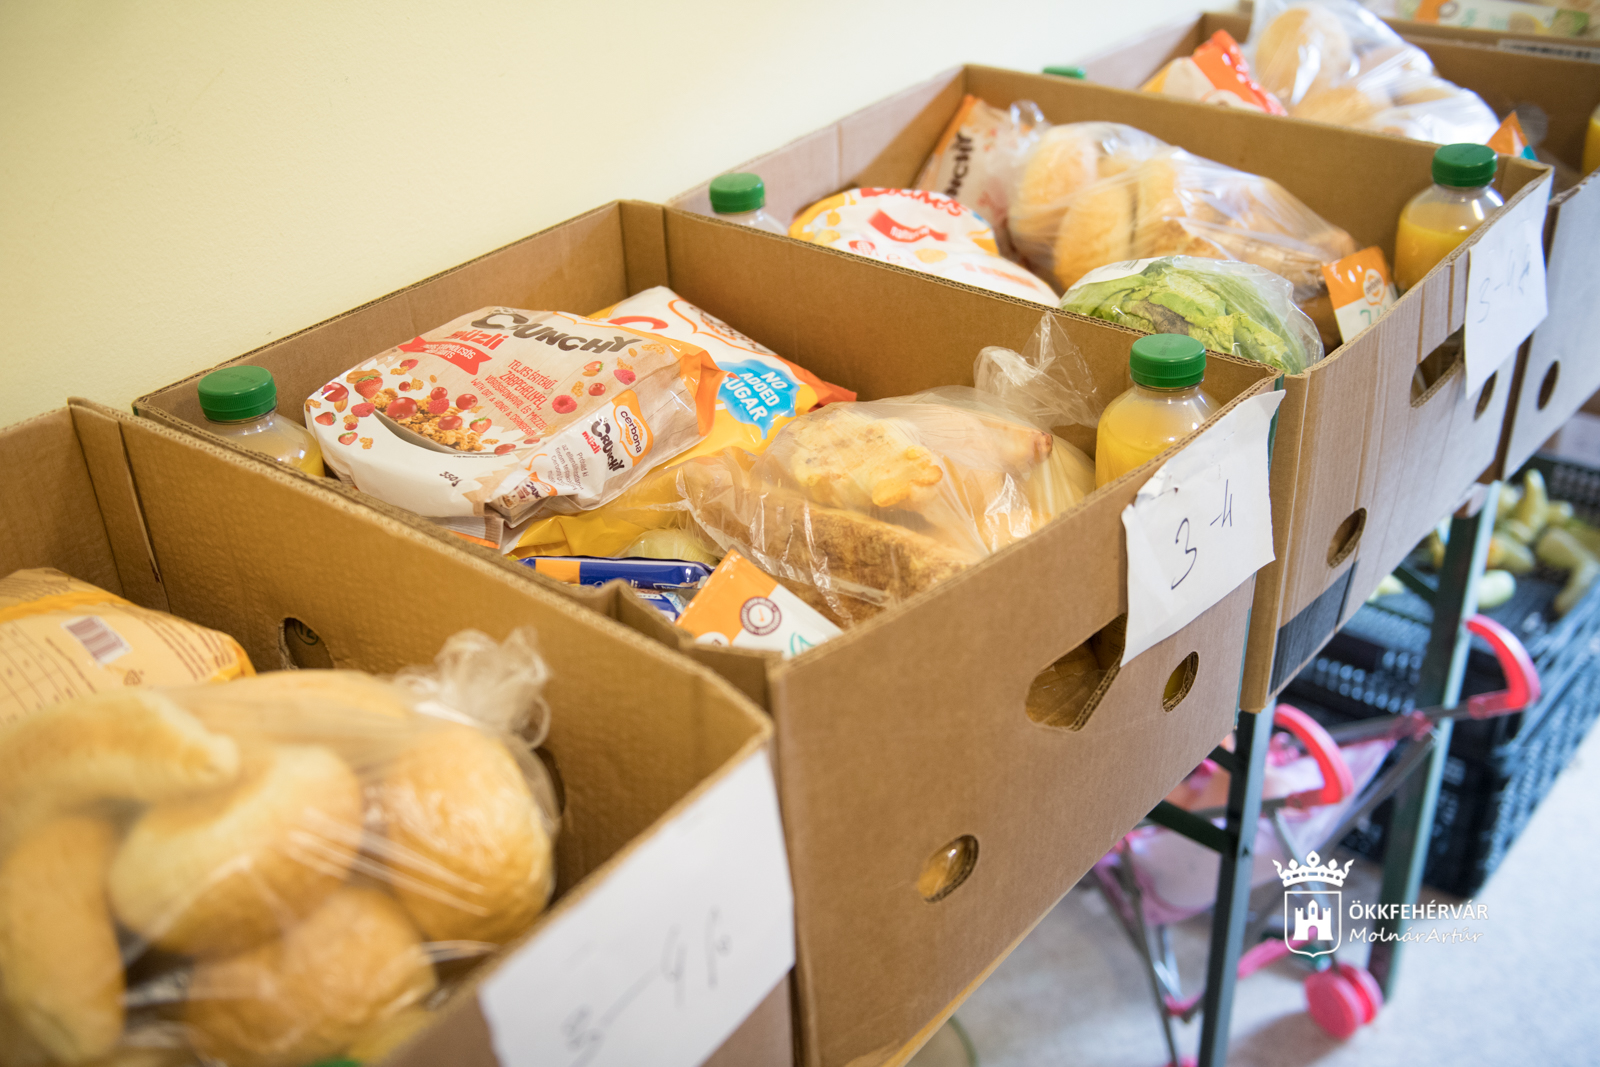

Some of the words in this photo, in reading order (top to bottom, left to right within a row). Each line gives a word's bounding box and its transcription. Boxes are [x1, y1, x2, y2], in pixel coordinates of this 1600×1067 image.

[508, 359, 534, 378] TELJES
[760, 371, 788, 389] NO
[471, 378, 486, 391] WITH
[481, 388, 494, 398] OAT
[493, 400, 510, 413] HONEY
[739, 373, 780, 406] ADDED
[520, 404, 532, 415] ÉS
[582, 431, 601, 454] müzli
[620, 411, 642, 453] cerbona
